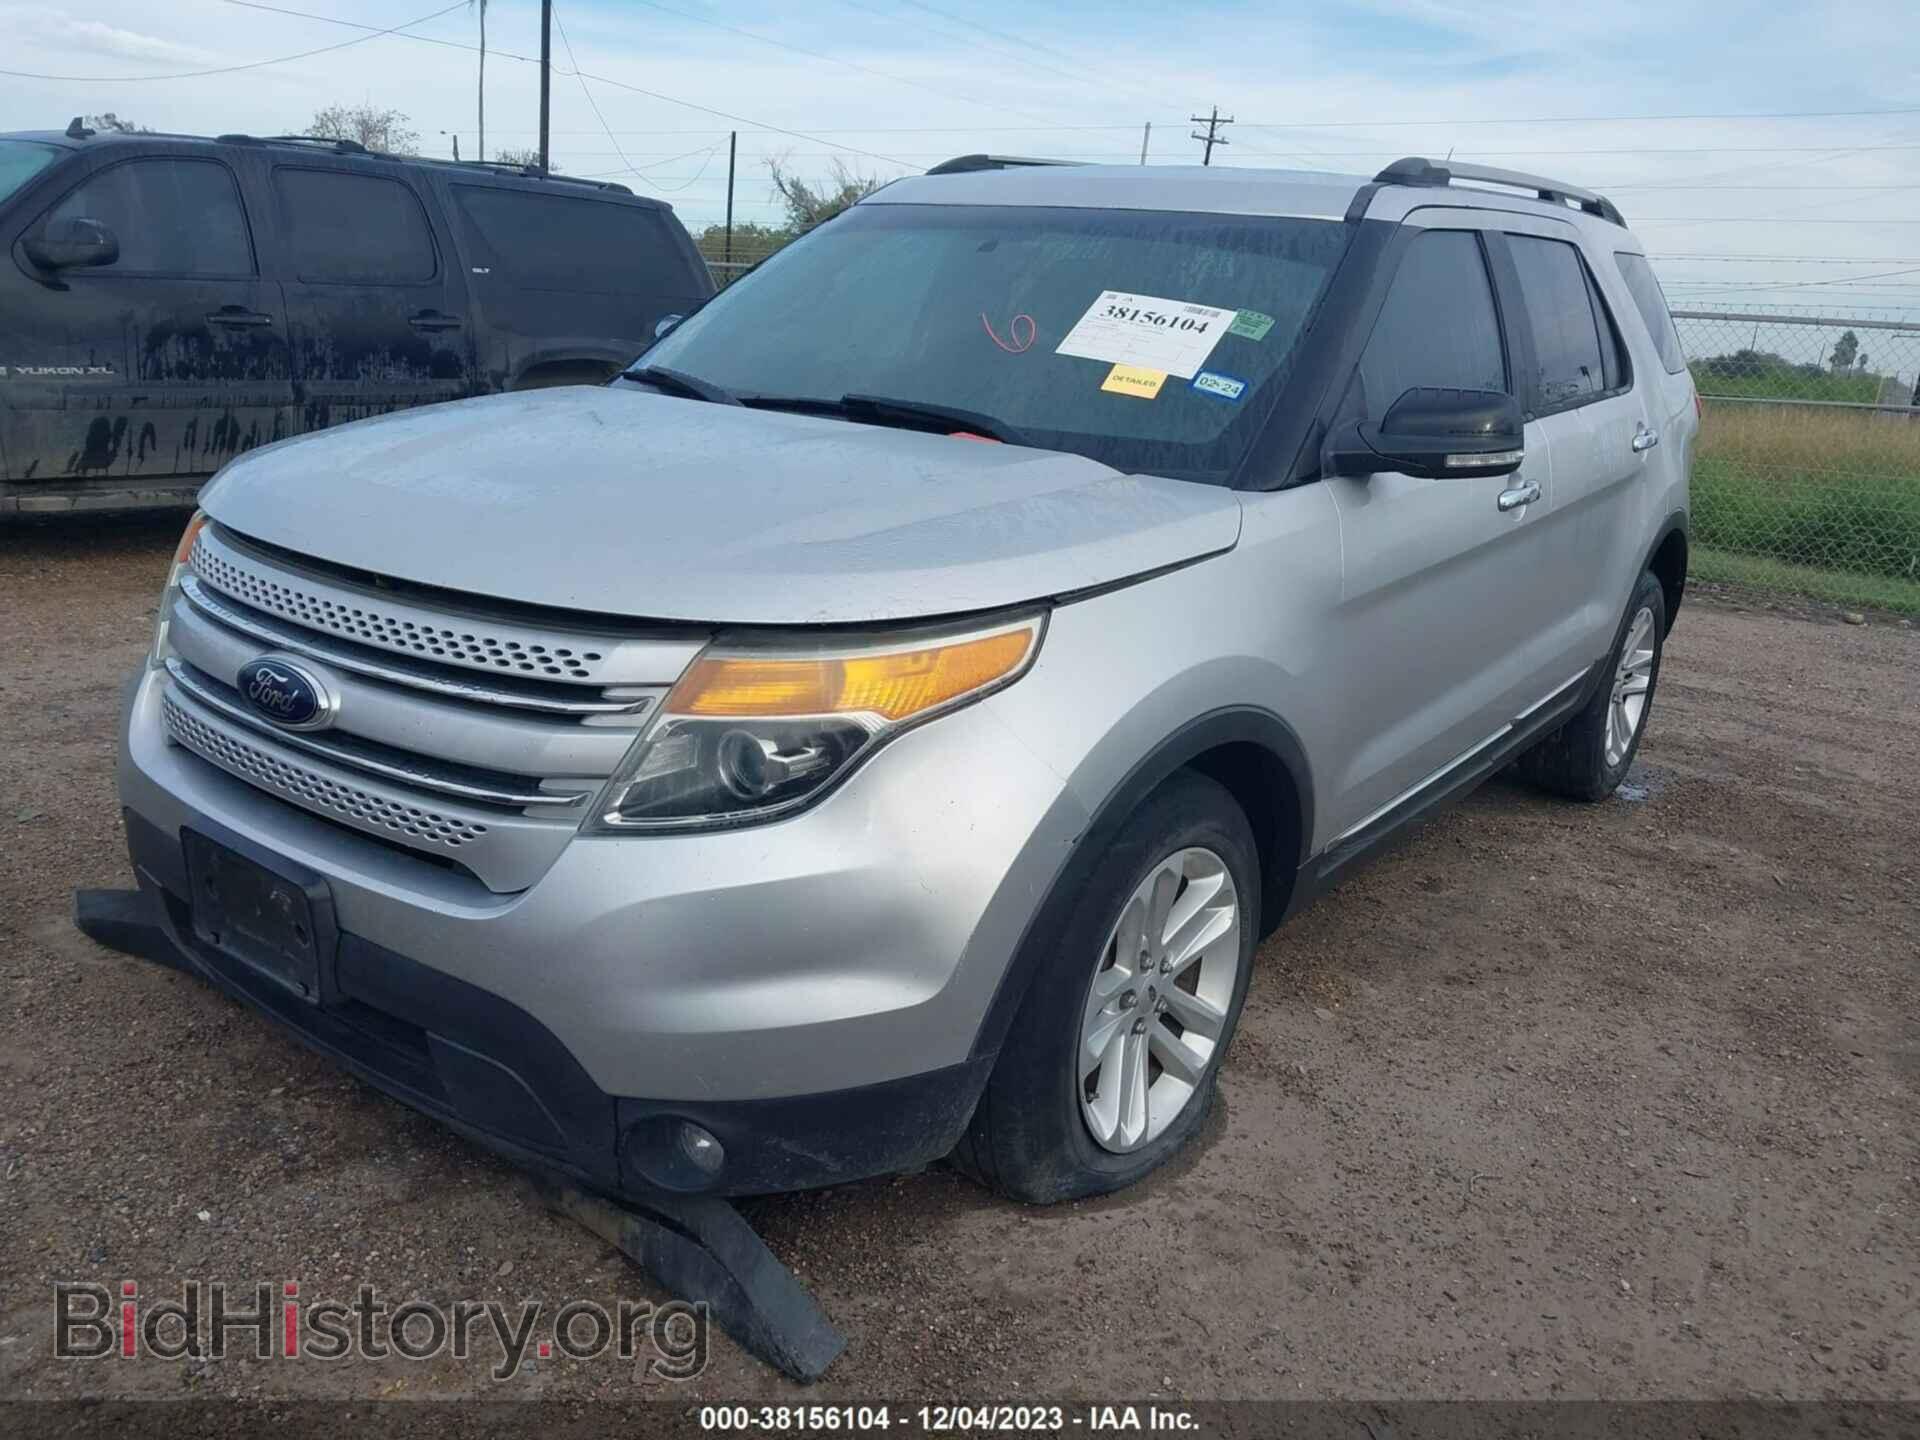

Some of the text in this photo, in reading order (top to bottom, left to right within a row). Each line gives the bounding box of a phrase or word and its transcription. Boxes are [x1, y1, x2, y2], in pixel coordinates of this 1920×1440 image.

[1099, 304, 1209, 334] 38156104
[16, 366, 83, 375] YUKON
[87, 366, 114, 375] XL
[1112, 375, 1157, 387] DETAILED
[248, 667, 299, 712] Ford
